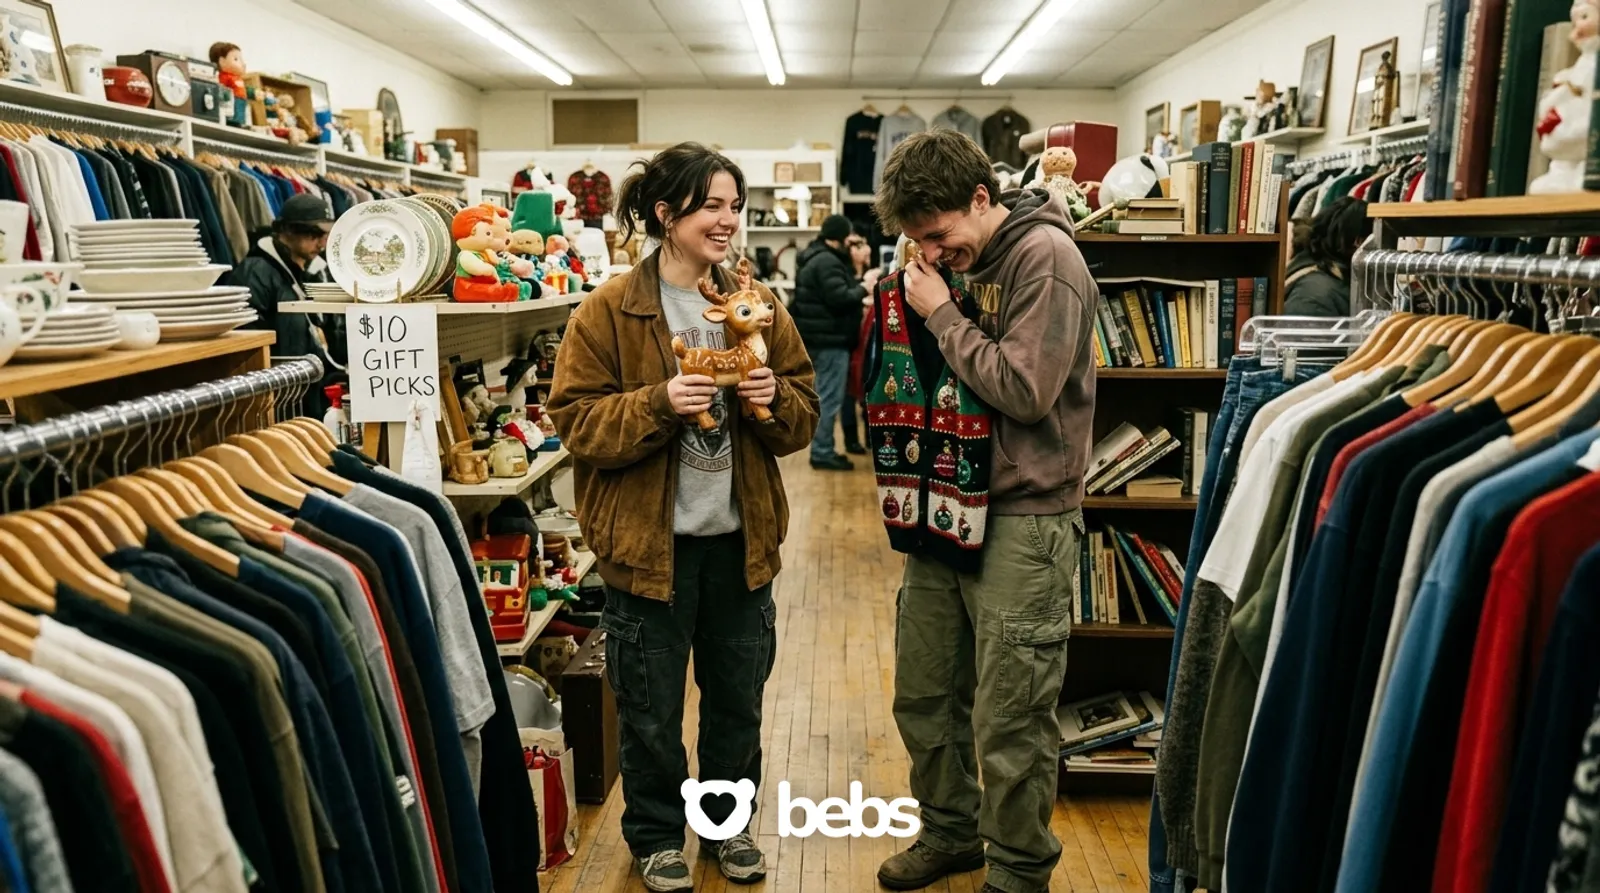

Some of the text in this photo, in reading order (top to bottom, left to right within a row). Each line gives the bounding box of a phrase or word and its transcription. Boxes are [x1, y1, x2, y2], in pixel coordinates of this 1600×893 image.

[358, 313, 407, 343] $10
[363, 348, 425, 371] GIFT
[368, 375, 435, 398] PICKS
